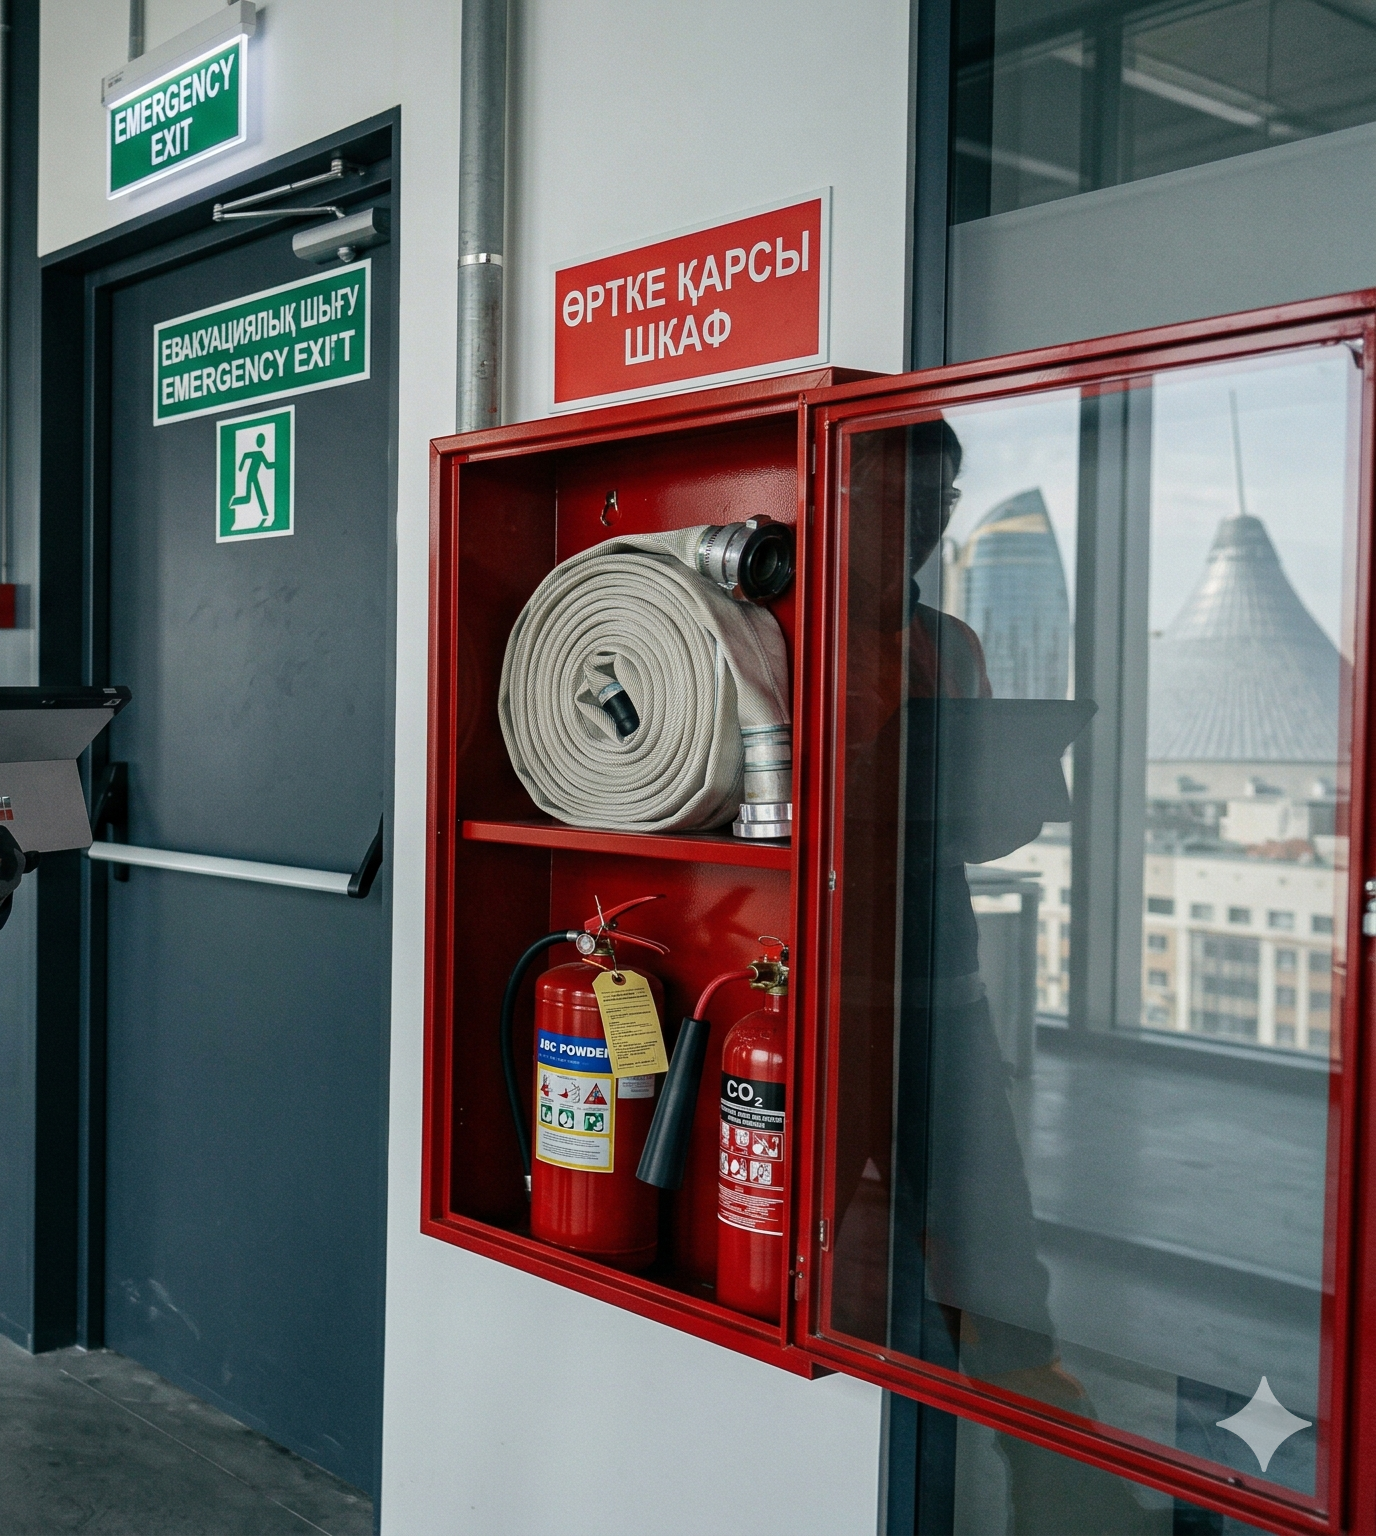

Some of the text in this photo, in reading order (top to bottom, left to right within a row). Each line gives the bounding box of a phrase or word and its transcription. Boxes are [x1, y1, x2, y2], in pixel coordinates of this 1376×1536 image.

[114, 53, 235, 145] EMERGENCY
[151, 116, 193, 166] EXIT
[562, 230, 809, 327] ӨРТКЕ ҚАРСЫ
[162, 284, 359, 367] ЕВАКУАЦИЯЛЫҚ ШЫҒУ
[625, 308, 732, 366] ШКАФ
[162, 346, 289, 406] EMERGENCY
